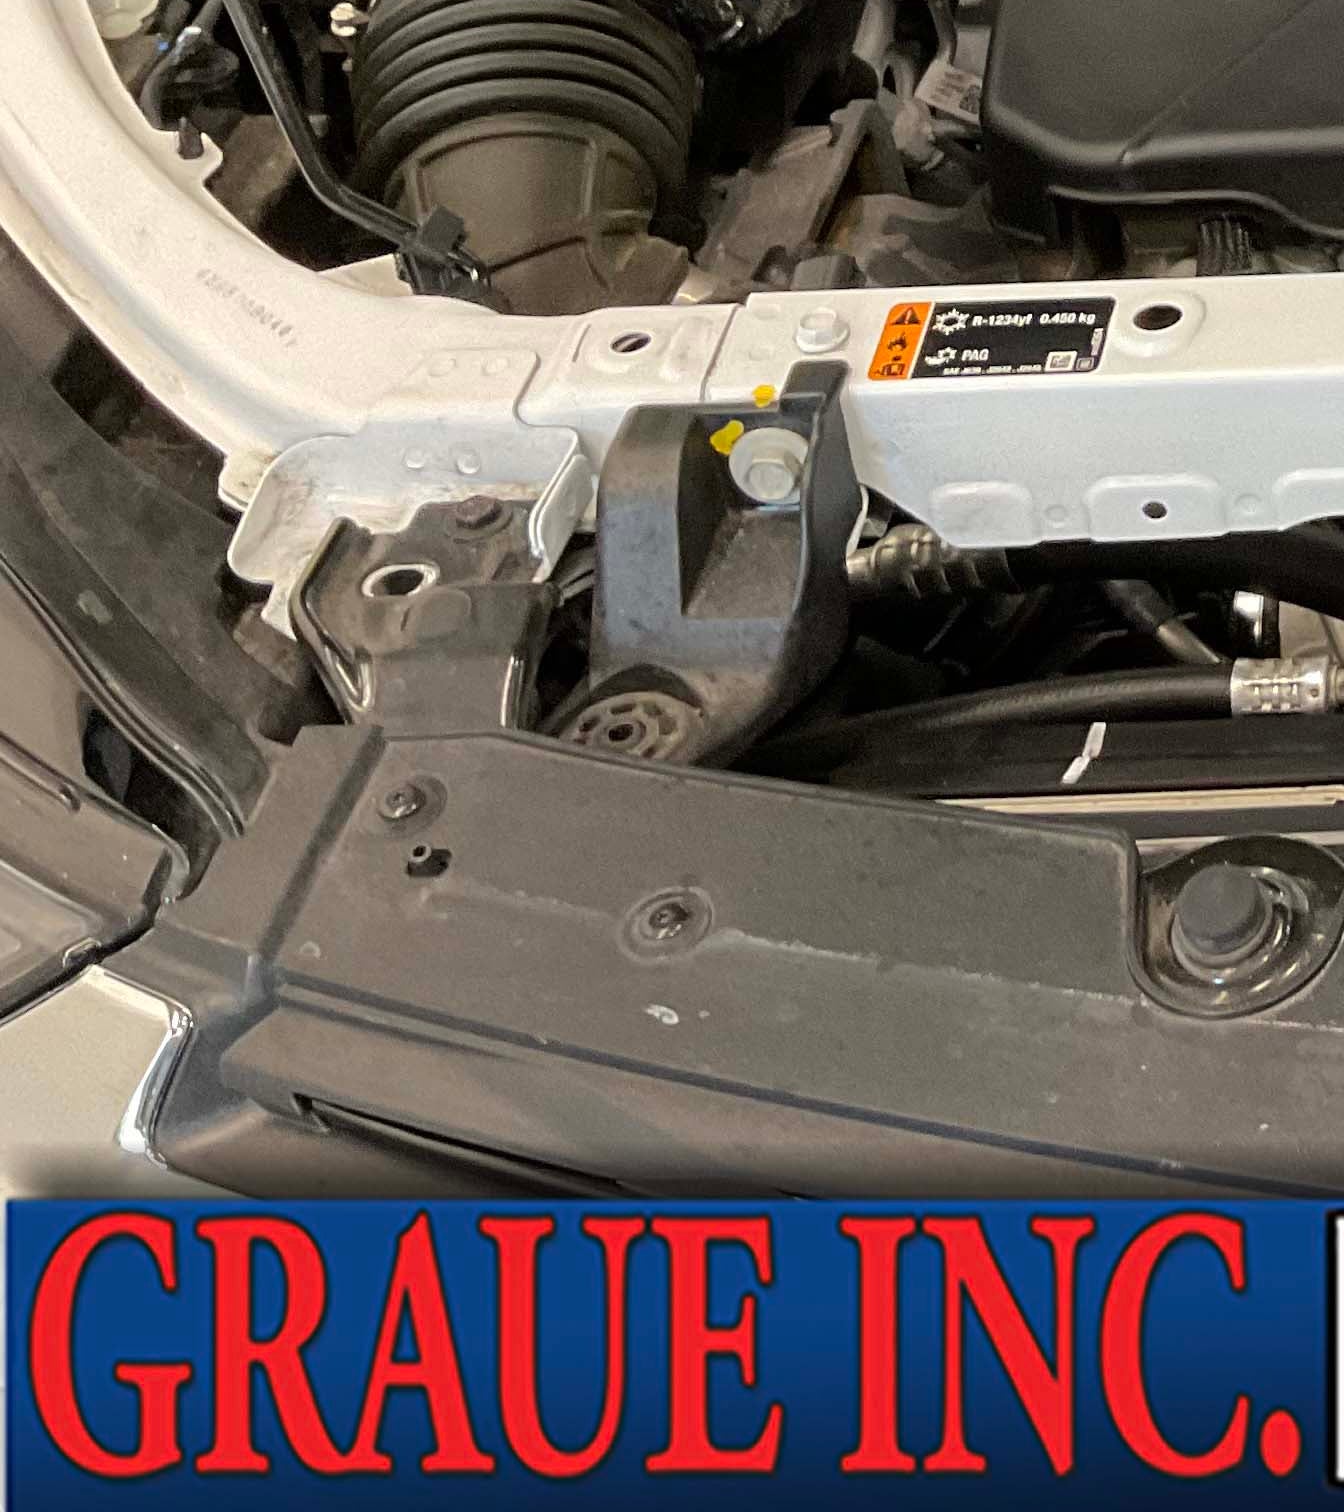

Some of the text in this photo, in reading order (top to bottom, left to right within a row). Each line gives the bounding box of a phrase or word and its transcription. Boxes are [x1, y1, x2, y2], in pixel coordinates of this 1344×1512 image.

[972, 313, 1033, 328] R-1234yf
[1078, 311, 1096, 327] kg
[961, 348, 990, 362] PAG
